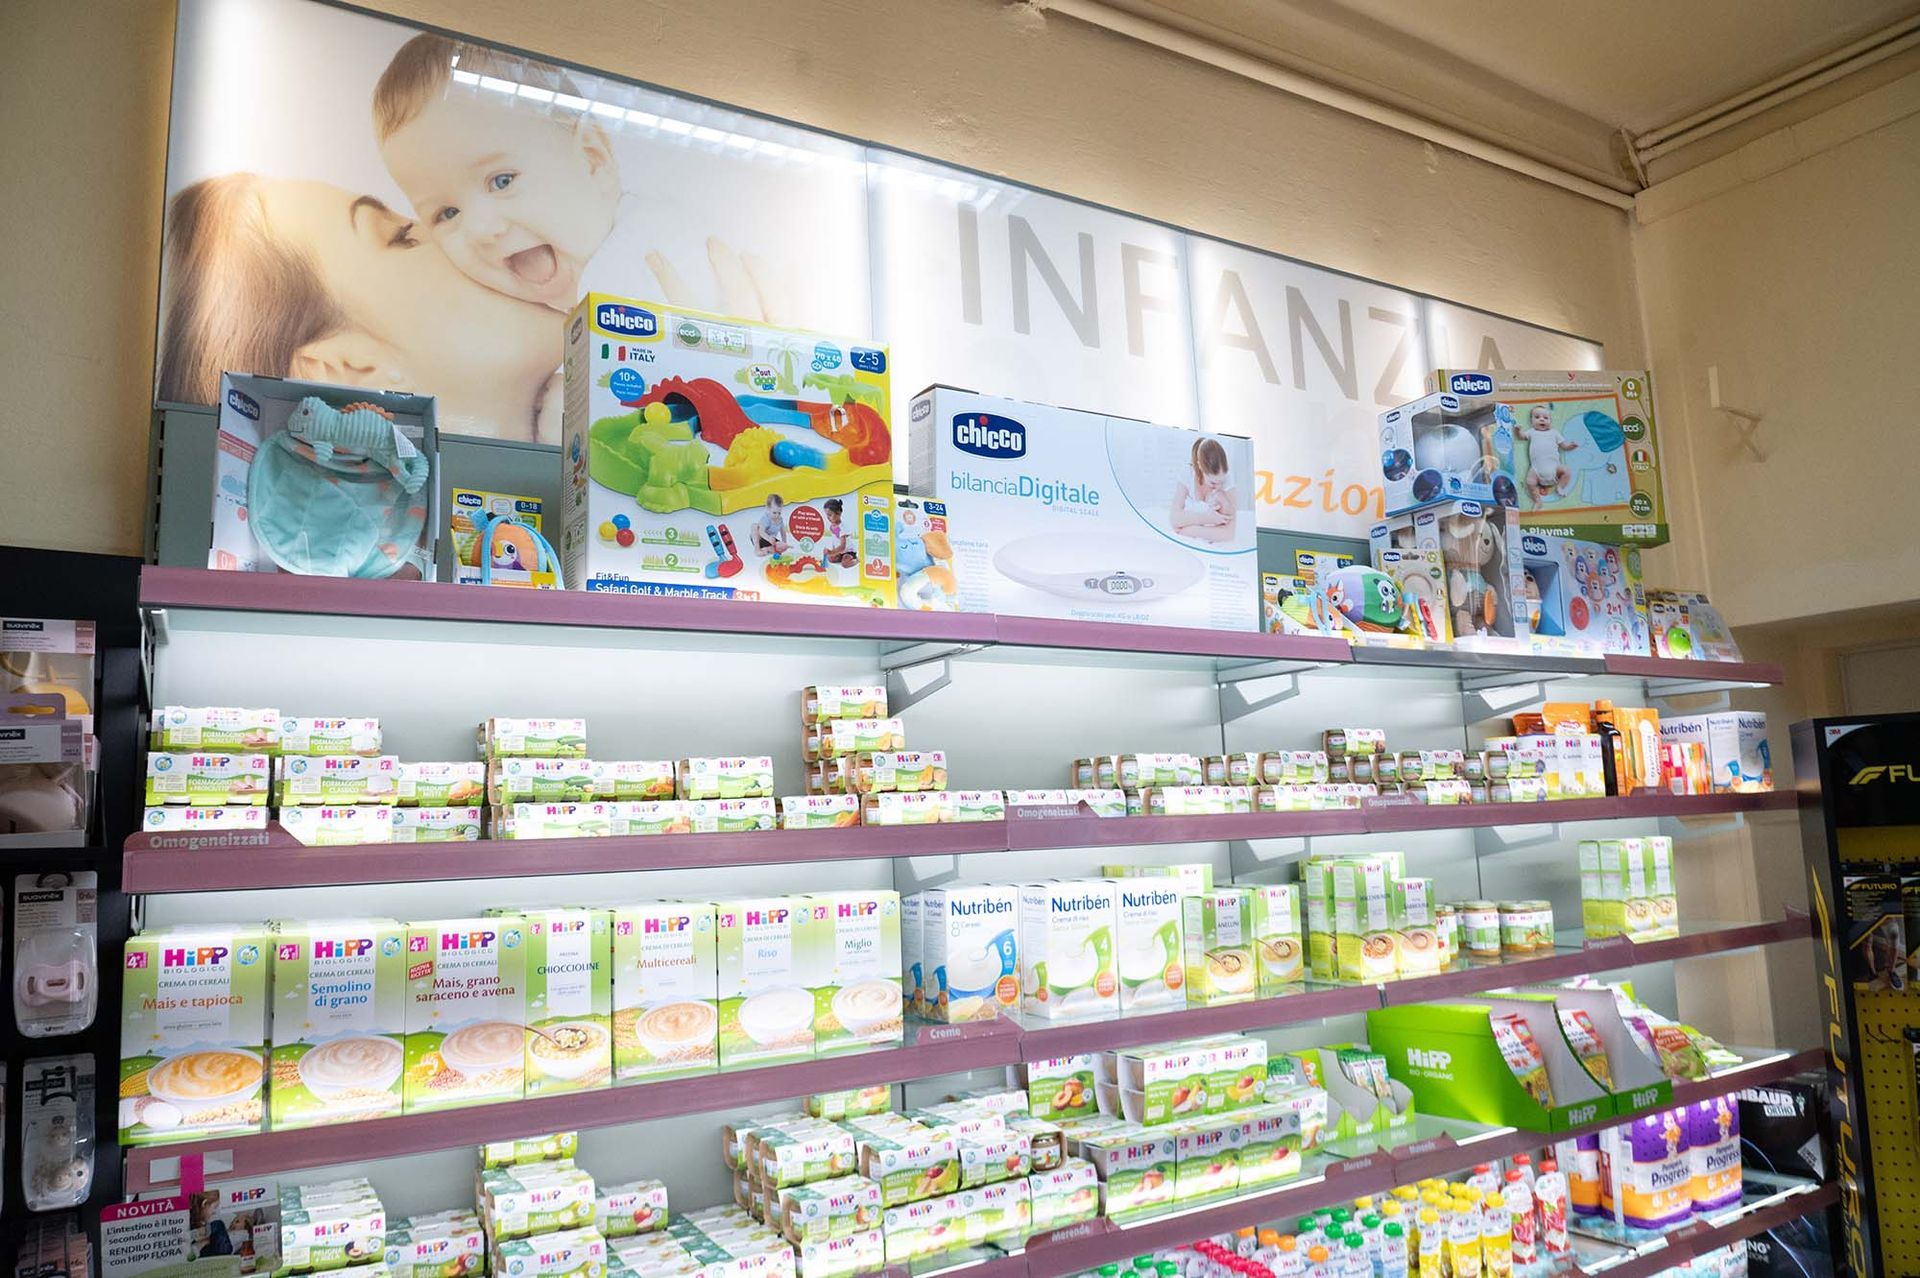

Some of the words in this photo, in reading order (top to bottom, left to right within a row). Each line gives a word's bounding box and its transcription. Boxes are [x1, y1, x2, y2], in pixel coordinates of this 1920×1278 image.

[600, 305, 654, 331] chicco
[629, 353, 656, 363] ITALY
[858, 351, 879, 366] 2-5
[618, 371, 637, 382] 10+
[1453, 373, 1491, 392] chicco
[229, 390, 261, 419] chicco
[957, 416, 1023, 452] chicco
[951, 472, 1100, 506] bilanciaDigitale
[457, 493, 482, 507] chicco
[595, 583, 628, 594] Safari
[630, 585, 652, 596] Golf
[653, 587, 663, 596] &
[664, 587, 699, 599] Marble
[701, 589, 728, 600] Track
[314, 720, 346, 729] HiPP
[192, 756, 231, 767] HiPP
[325, 759, 361, 769] HiPP
[535, 761, 564, 771] HiPP
[720, 760, 746, 769] HiPP
[546, 805, 577, 815] HiPP
[720, 801, 746, 810] HiPP
[186, 810, 224, 820] HiPP
[321, 809, 356, 819] HiPP
[150, 832, 269, 850] Omogeneizzati
[1052, 893, 1111, 913] Nutribén
[1122, 890, 1177, 908] Nutribén
[838, 901, 878, 918] HiPP
[951, 897, 1013, 917] Nutribén
[644, 916, 690, 933] HiPP
[747, 909, 789, 926] HiPP
[552, 920, 585, 933] HiPP
[314, 938, 373, 958] HiPP
[442, 931, 496, 950] HiPP
[844, 939, 872, 951] Miglio
[1002, 940, 1012, 956] 6
[164, 946, 229, 967] HiPP
[313, 956, 371, 965] BIOLOGICO
[441, 949, 494, 957] BIOLOGICO
[757, 949, 778, 959] Riso
[163, 965, 225, 974] BIOLOGICO
[470, 959, 497, 967] CEREALI
[537, 961, 600, 975] CHIOCCIOLINE
[636, 955, 697, 969] Multicereali
[309, 970, 336, 978] CREMA
[336, 969, 346, 977] DI
[346, 967, 375, 976] CEREALI
[158, 980, 187, 988] CREMA
[199, 978, 230, 986] CEREALI
[311, 981, 372, 995] Semolino
[432, 976, 464, 989] Mais,
[466, 976, 501, 989] grano
[142, 997, 176, 1010] Mais
[180, 999, 188, 1008] e
[191, 993, 244, 1009] tapioca
[314, 994, 327, 1007] di
[330, 995, 368, 1009] grano
[416, 990, 469, 1002] saraceno
[472, 989, 479, 997] e
[481, 987, 516, 997] avena
[929, 1027, 961, 1039] Creme
[1224, 1048, 1249, 1060] HiPP
[1406, 1047, 1452, 1070] HiPP
[1164, 1056, 1190, 1069] HiPP
[1633, 1088, 1658, 1109] HiPP
[1568, 1104, 1597, 1126] HiPP
[1766, 1105, 1793, 1116] ORTHO
[1258, 1117, 1283, 1132] HiPP
[1197, 1131, 1223, 1146] HiPP
[1128, 1143, 1155, 1158] HiPP
[1706, 1149, 1740, 1170] Progress
[1651, 1166, 1690, 1187] Progress
[231, 1187, 266, 1203] HiPP
[531, 1189, 561, 1203] HiPP
[117, 1200, 175, 1218] NOVITÀ
[106, 1221, 153, 1235] L'intestino
[154, 1220, 161, 1228] è
[168, 1217, 184, 1226] tuo
[315, 1222, 350, 1236] HiPP
[1051, 1224, 1091, 1243] Merende
[108, 1232, 146, 1245] secondo
[147, 1227, 183, 1239] cervello
[109, 1243, 151, 1257] RENDILO
[416, 1241, 449, 1255] HiPP
[109, 1257, 127, 1267] con
[151, 1247, 183, 1260] FLORA
[540, 1250, 572, 1265] HiPP
[739, 1256, 767, 1270] HiPP
